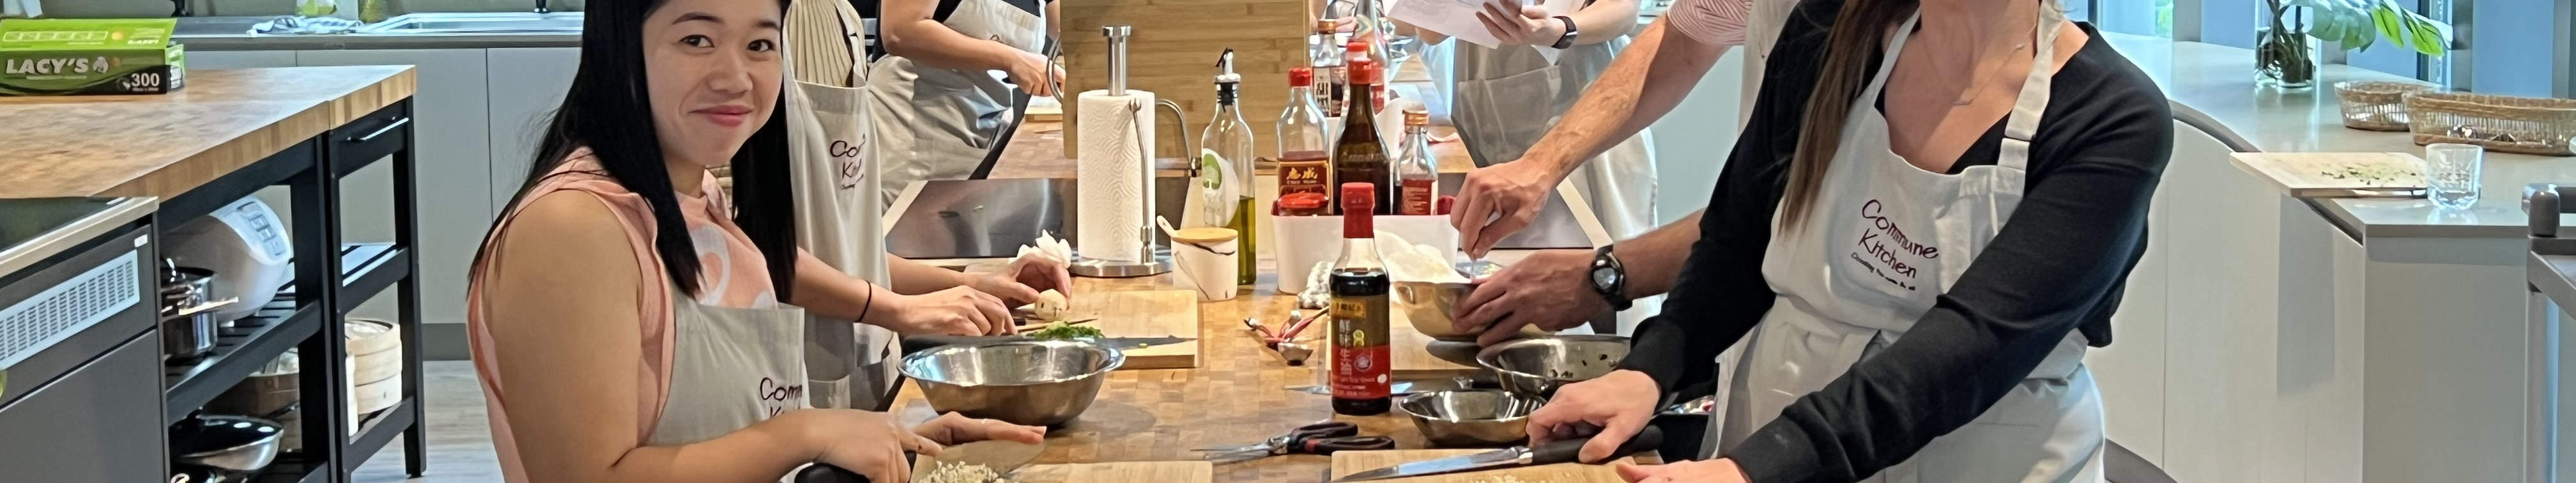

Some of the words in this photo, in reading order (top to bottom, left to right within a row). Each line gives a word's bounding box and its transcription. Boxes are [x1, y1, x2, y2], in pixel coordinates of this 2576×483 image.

[6, 58, 89, 73] LACY'S
[131, 73, 160, 87] 300
[1862, 199, 1939, 259] Commune
[1858, 228, 1917, 279] Kitchen
